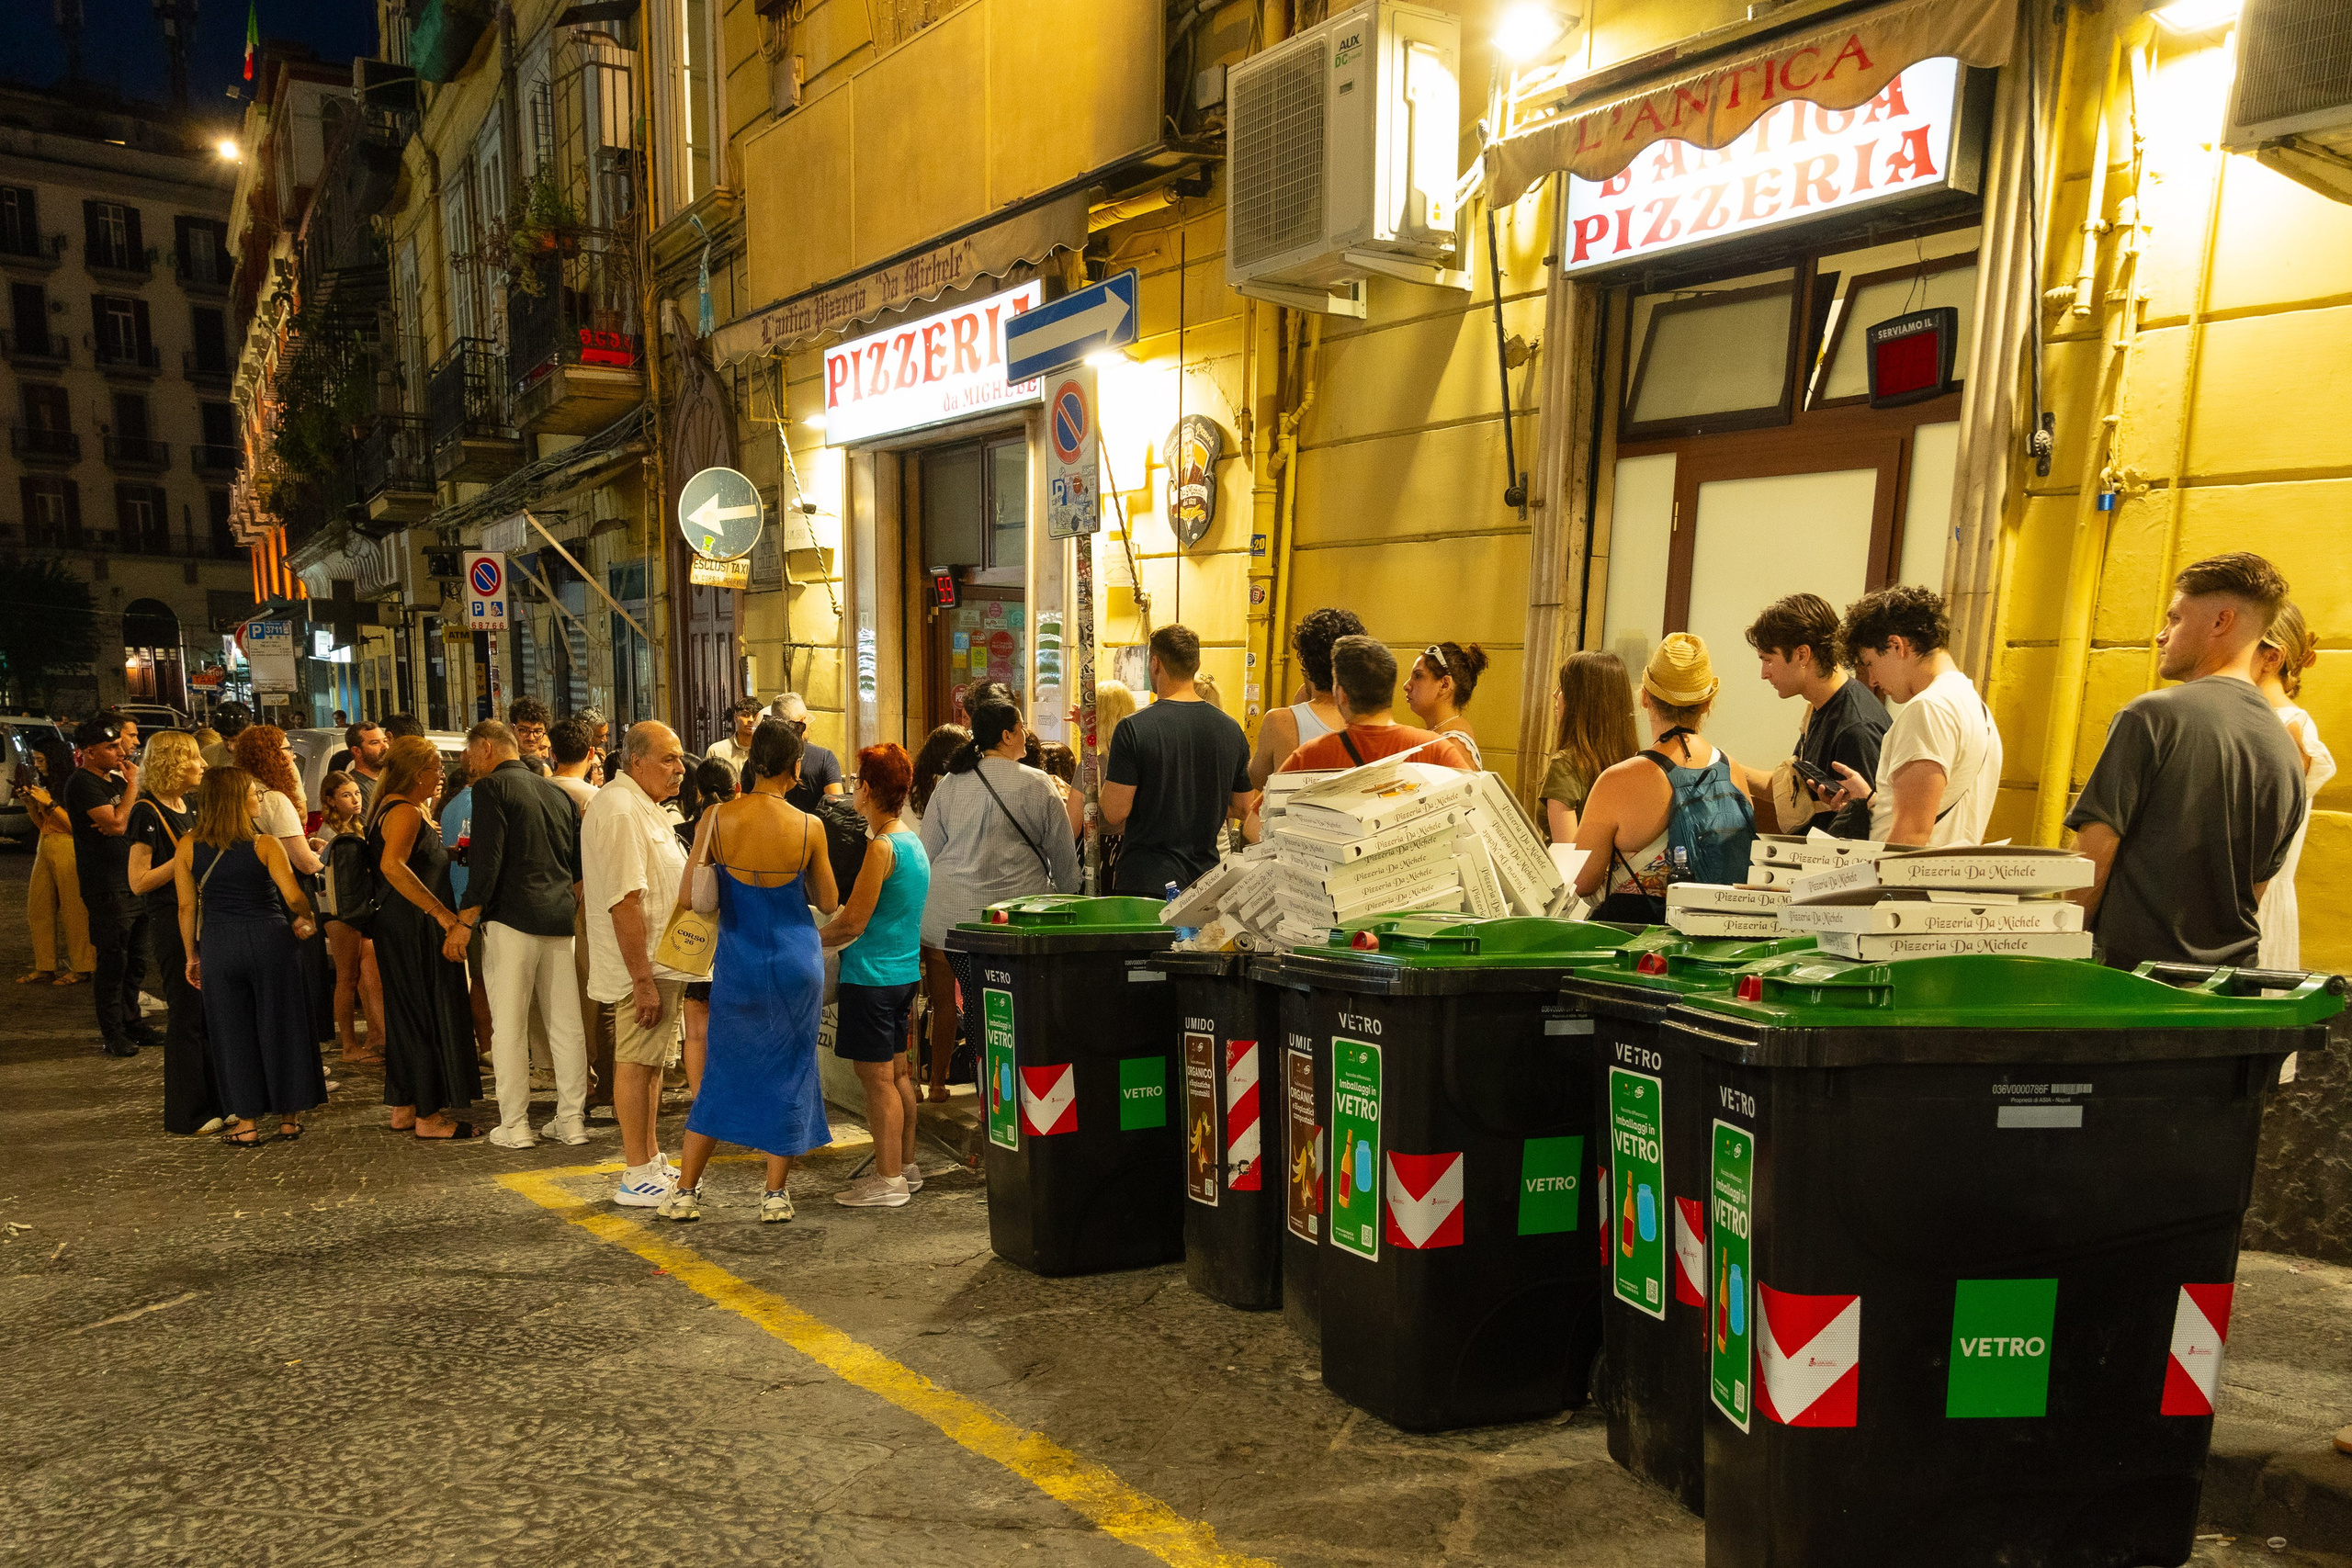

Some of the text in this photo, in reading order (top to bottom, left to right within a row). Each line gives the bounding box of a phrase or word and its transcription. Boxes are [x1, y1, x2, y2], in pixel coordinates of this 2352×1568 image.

[1339, 33, 1360, 51] AUX
[1335, 53, 1348, 69] DC
[1574, 33, 1874, 154] L'ANTICA
[1570, 124, 1938, 265] PIZZERIA
[815, 283, 866, 334] Pizzeria
[1877, 318, 1933, 339] SERVIAMO IL
[943, 392, 958, 412] da
[730, 562, 749, 575] TAXI
[937, 576, 954, 603] 59
[474, 603, 482, 615] P
[252, 625, 283, 637] P 3711
[447, 631, 470, 639] ATM
[471, 622, 504, 630] 68766
[195, 675, 215, 683] TAXI
[1394, 793, 1459, 822] Pizzeria Da Michele
[1375, 821, 1442, 851] Pizzeria Da Michele
[1499, 803, 1547, 870] Pizzeria Da Michele
[1364, 836, 1437, 863] Pizzeria Da Michele
[1489, 819, 1537, 886] Pizzeria Da Michele
[1353, 854, 1427, 884] Pizzeria Da Michele
[1790, 852, 1830, 866] Pizzeria
[1833, 857, 1849, 869] Da
[1907, 864, 2037, 881] Pizzeria Da Michele
[1362, 868, 1432, 897] Pizzeria Da Michele
[1479, 866, 1496, 899] Pizzeria
[1490, 898, 1501, 914] Da
[1365, 884, 1434, 912] Pizzeria Da Michele
[1714, 891, 1756, 905] Pizzeria
[1758, 895, 1775, 906] Da
[1724, 920, 1768, 933] Pizzeria
[1925, 914, 2041, 933] Pizzeria Da Michele
[677, 929, 706, 942] CORSO
[684, 938, 695, 946] 26
[1890, 938, 2028, 955] Pizzeria Da Michele
[985, 969, 1011, 984] VETRO
[1185, 1017, 1215, 1032] UMIDO
[1339, 1011, 1382, 1035] VETRO
[988, 1029, 1012, 1049] VETRO
[1289, 1032, 1312, 1051] UMID
[1615, 1042, 1662, 1070] VETRO
[1187, 1066, 1213, 1079] ORGANICO
[1123, 1085, 1163, 1100] VETRO
[1290, 1087, 1314, 1106] ORGANIC
[1339, 1078, 1377, 1097] Imballaggi in
[1992, 1084, 2050, 1094] 036V0000786F
[1336, 1091, 1378, 1122] VETRO
[1719, 1085, 1755, 1119] VETRO
[1615, 1113, 1656, 1135] Imballaggi in
[1614, 1128, 1659, 1164] VETRO
[1525, 1176, 1577, 1192] VETRO
[1715, 1177, 1742, 1204] Imballaggi
[1713, 1195, 1748, 1240] VETRO
[1960, 1337, 2045, 1358] VETRO
